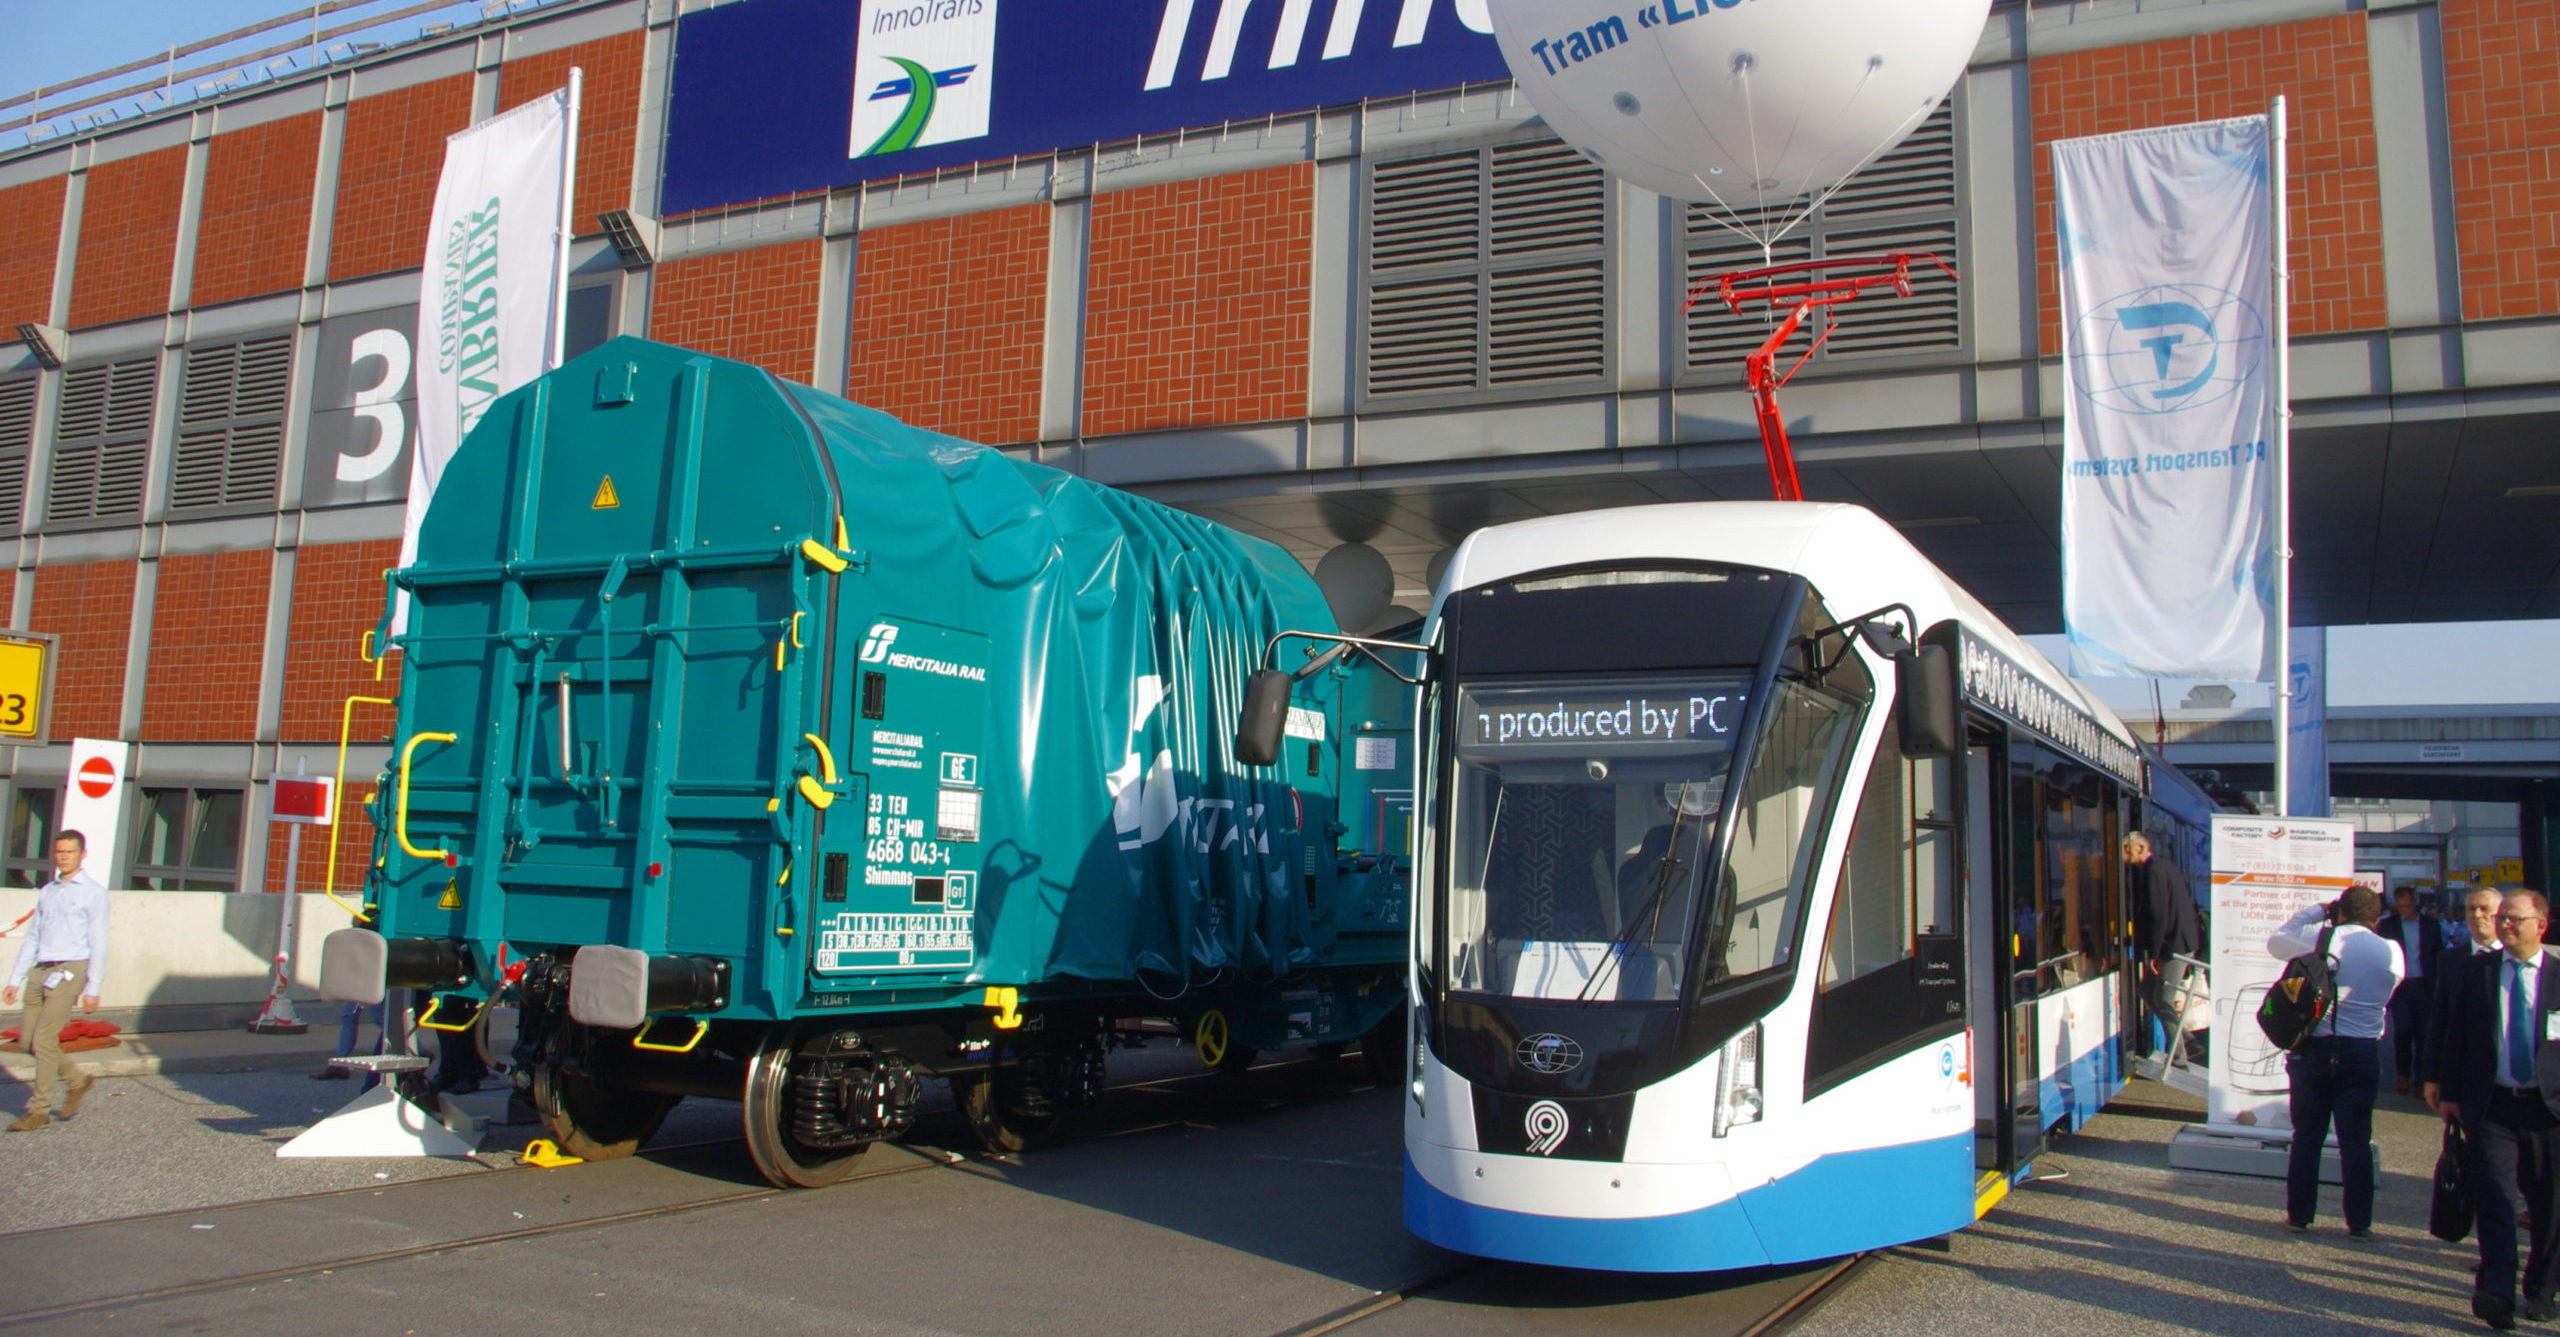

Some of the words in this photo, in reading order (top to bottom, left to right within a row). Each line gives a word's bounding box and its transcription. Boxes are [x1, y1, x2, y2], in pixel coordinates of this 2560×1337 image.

[1531, 15, 1629, 76] Tram
[336, 328, 411, 482] 3
[888, 652, 957, 677] MERCITALIA
[958, 664, 986, 682] RAIL
[0, 694, 26, 725] 3
[1499, 699, 1631, 743] produced
[1641, 699, 1679, 742] by
[1689, 696, 1728, 734] PC
[951, 758, 966, 780] GE
[869, 794, 882, 814] 33
[888, 796, 908, 816] TEN
[868, 817, 881, 836] 85
[886, 819, 923, 839] CH-MIR
[866, 840, 904, 863] 4668
[911, 841, 950, 865] 043-4
[865, 863, 913, 886] Shimmns
[2244, 889, 2279, 898] Partner
[2250, 901, 2282, 911] project
[821, 952, 836, 967] 120
